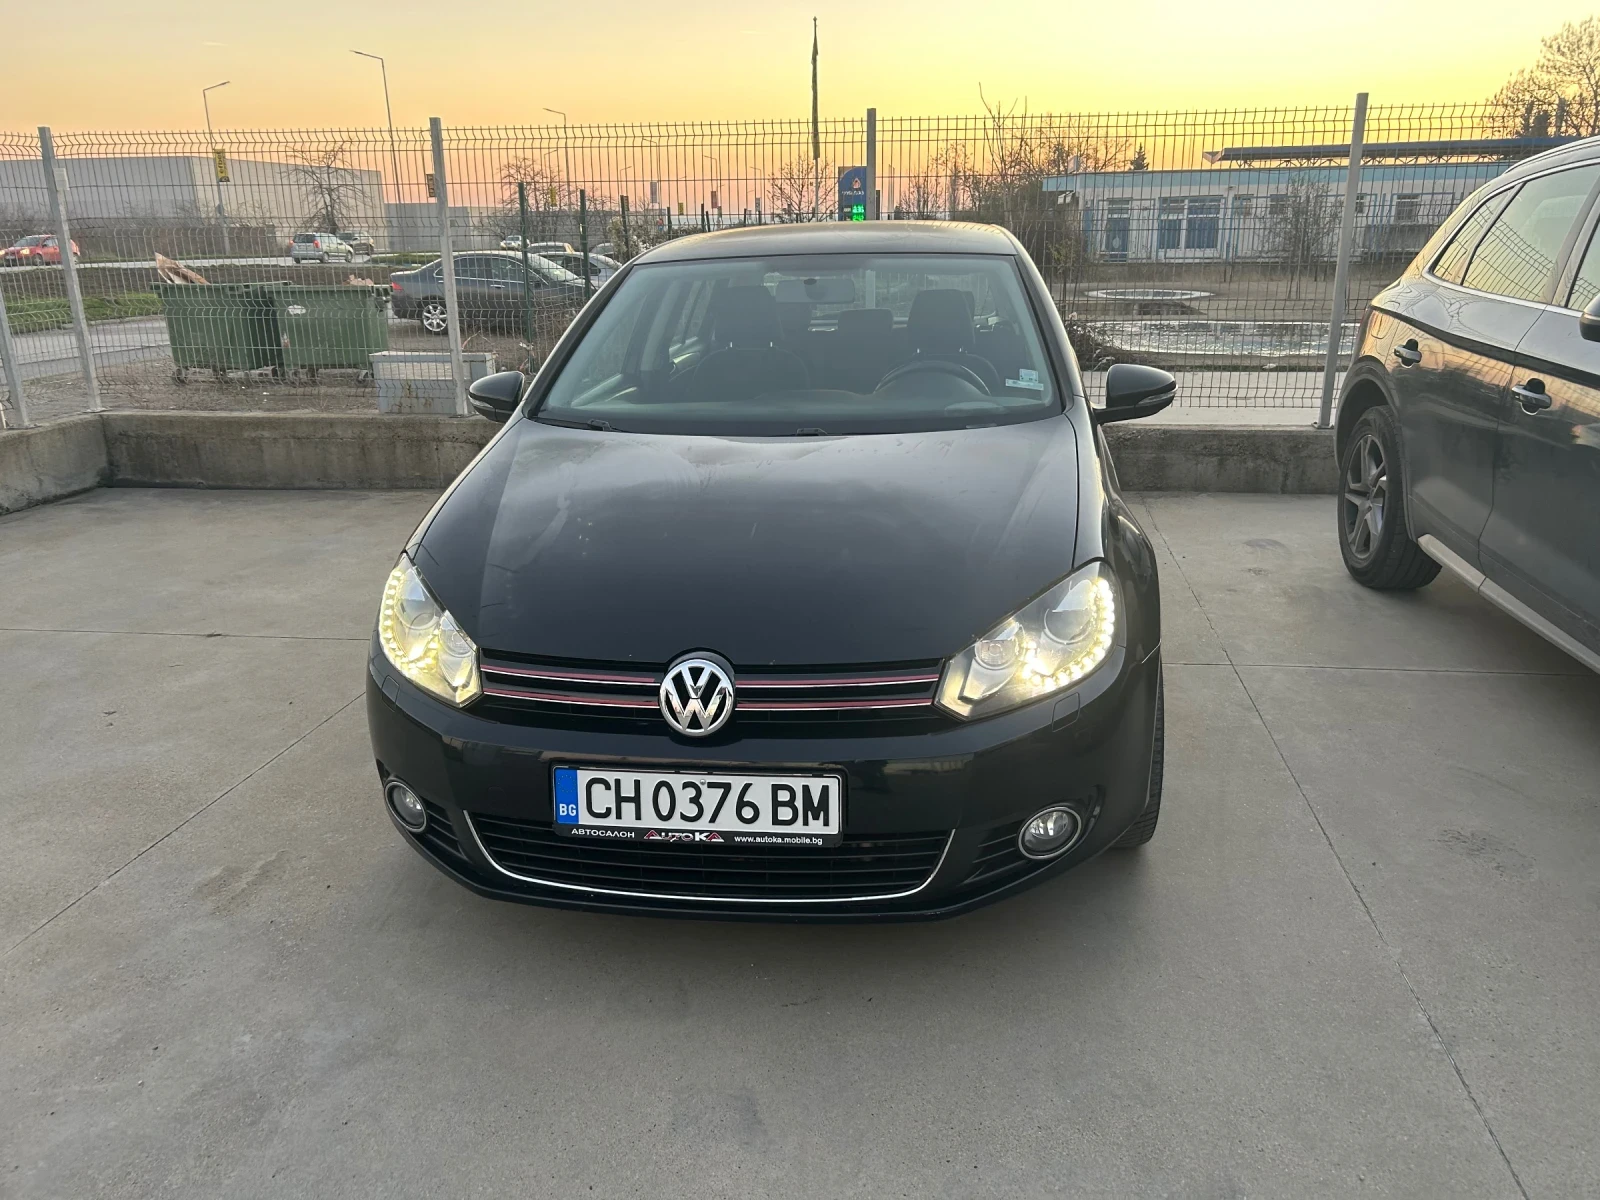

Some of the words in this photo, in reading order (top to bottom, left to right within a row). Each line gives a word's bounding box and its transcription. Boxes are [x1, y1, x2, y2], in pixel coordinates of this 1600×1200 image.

[585, 777, 642, 821] CH
[652, 780, 760, 824] 0376
[771, 783, 830, 827] BM
[559, 803, 577, 816] BG
[571, 828, 635, 839] АВТОСАЛОН
[734, 836, 823, 846] www.autoka.mobile.bg
